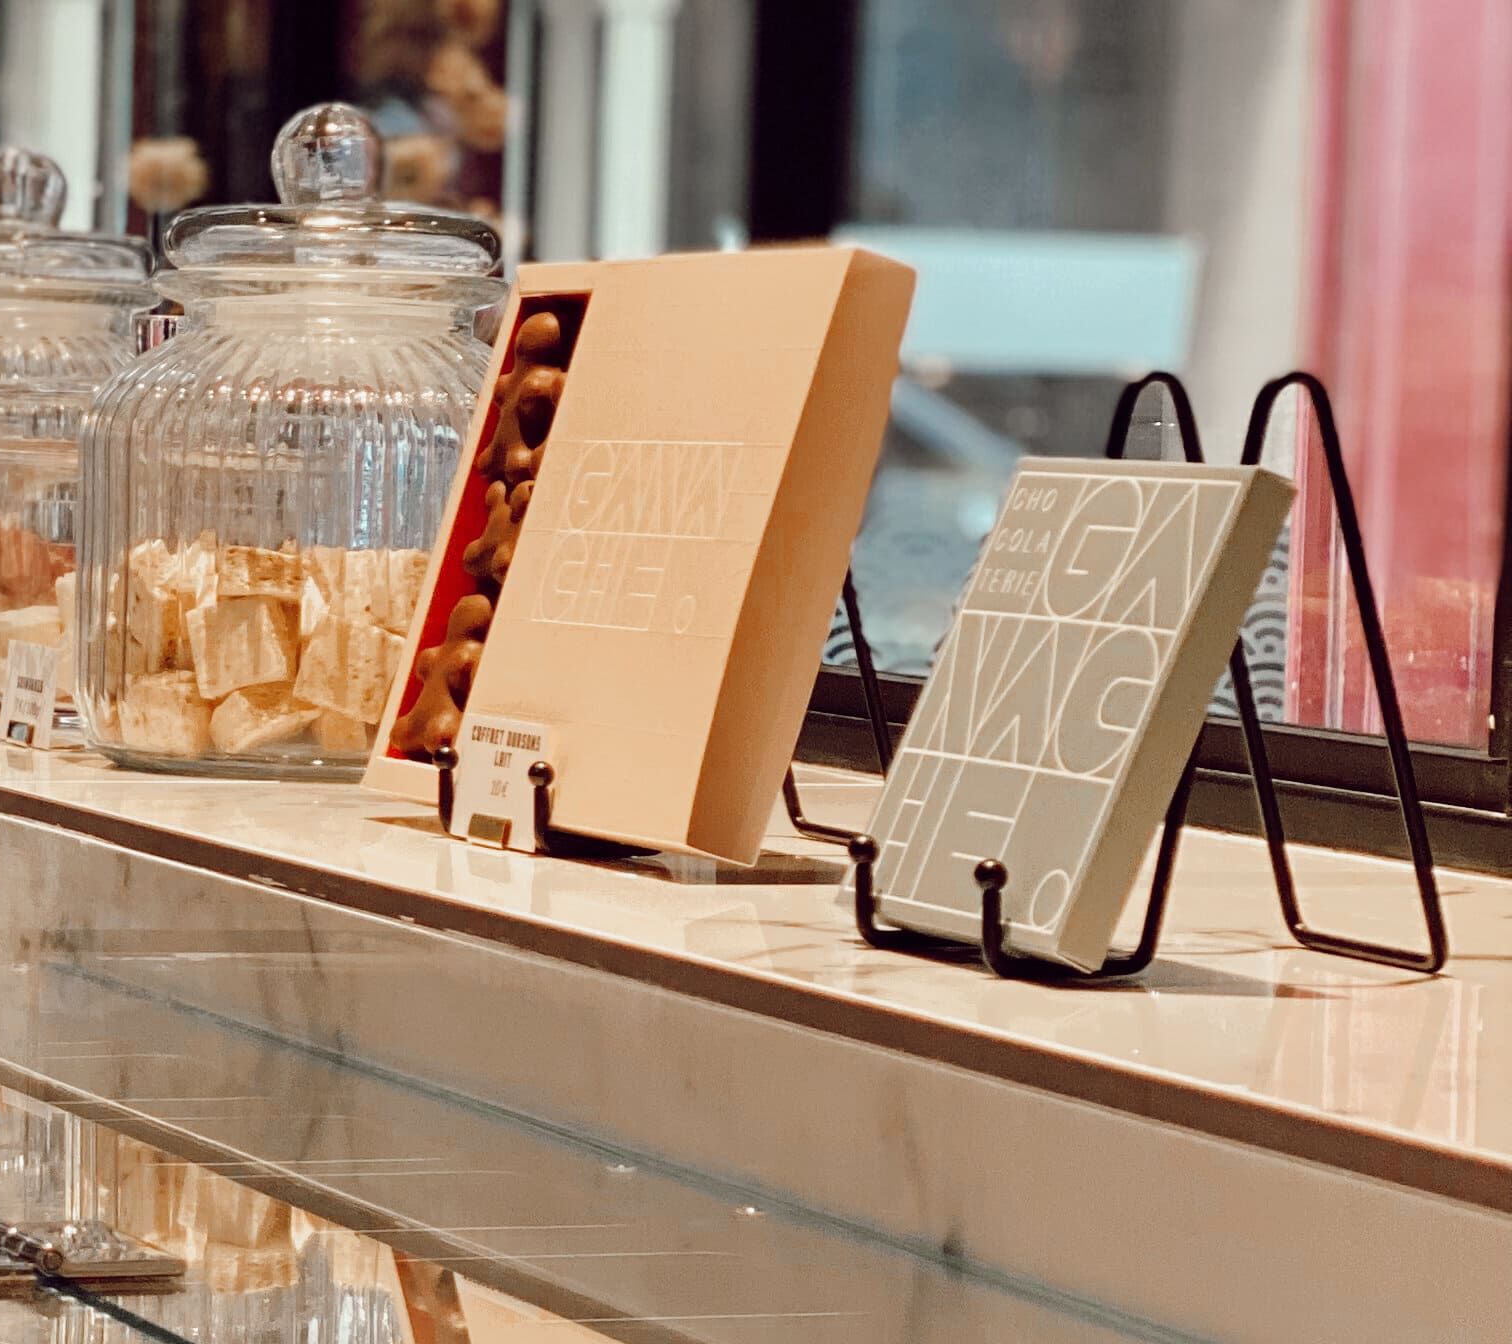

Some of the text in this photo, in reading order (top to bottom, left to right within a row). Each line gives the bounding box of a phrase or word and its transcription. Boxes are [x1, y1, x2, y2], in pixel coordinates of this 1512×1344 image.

[1011, 487, 1058, 512] CHO
[994, 527, 1052, 553] COLA
[977, 567, 1042, 596] TERIE
[471, 724, 505, 745] COFFRET
[494, 750, 513, 769] LAIT
